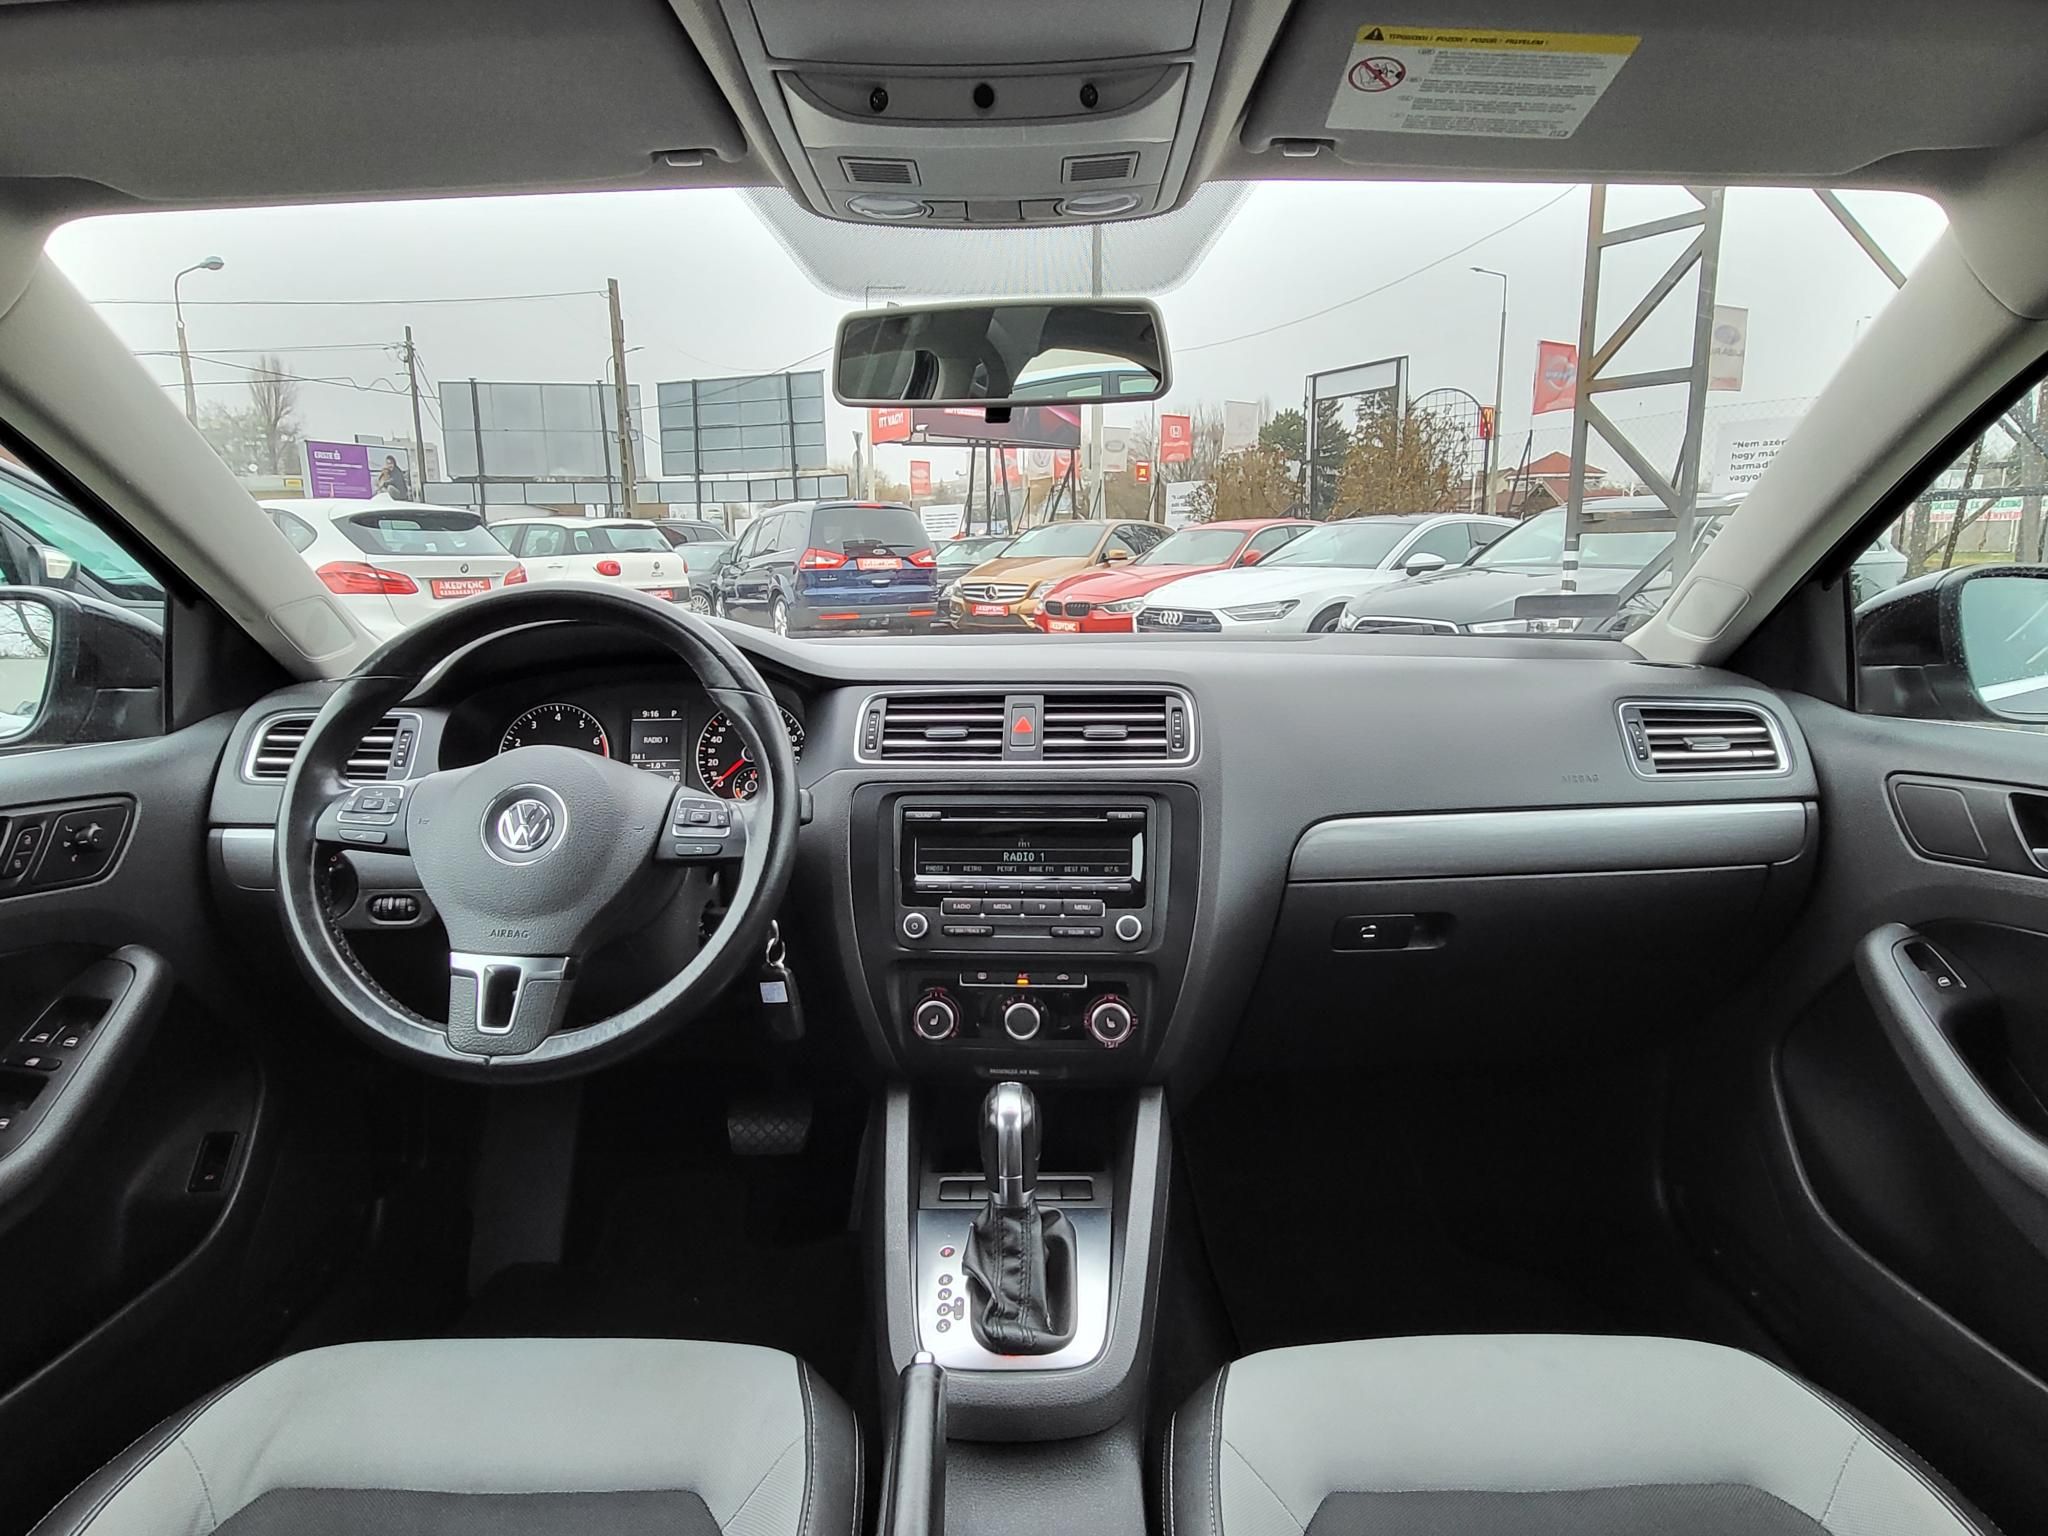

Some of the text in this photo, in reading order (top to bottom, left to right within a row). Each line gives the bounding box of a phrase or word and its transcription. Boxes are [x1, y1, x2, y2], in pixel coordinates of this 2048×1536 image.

[1731, 452, 1756, 461] hogy
[1730, 460, 1772, 471] harmad
[555, 712, 562, 721] 4
[642, 710, 660, 718] 9:16
[531, 720, 537, 729] 3
[579, 720, 585, 728] 5
[515, 738, 521, 747] 2
[593, 737, 600, 745] 6
[643, 736, 663, 744] RADIO
[710, 736, 723, 744] 40
[1003, 852, 1045, 862] RADIO 1
[489, 929, 529, 939] AIRBAG
